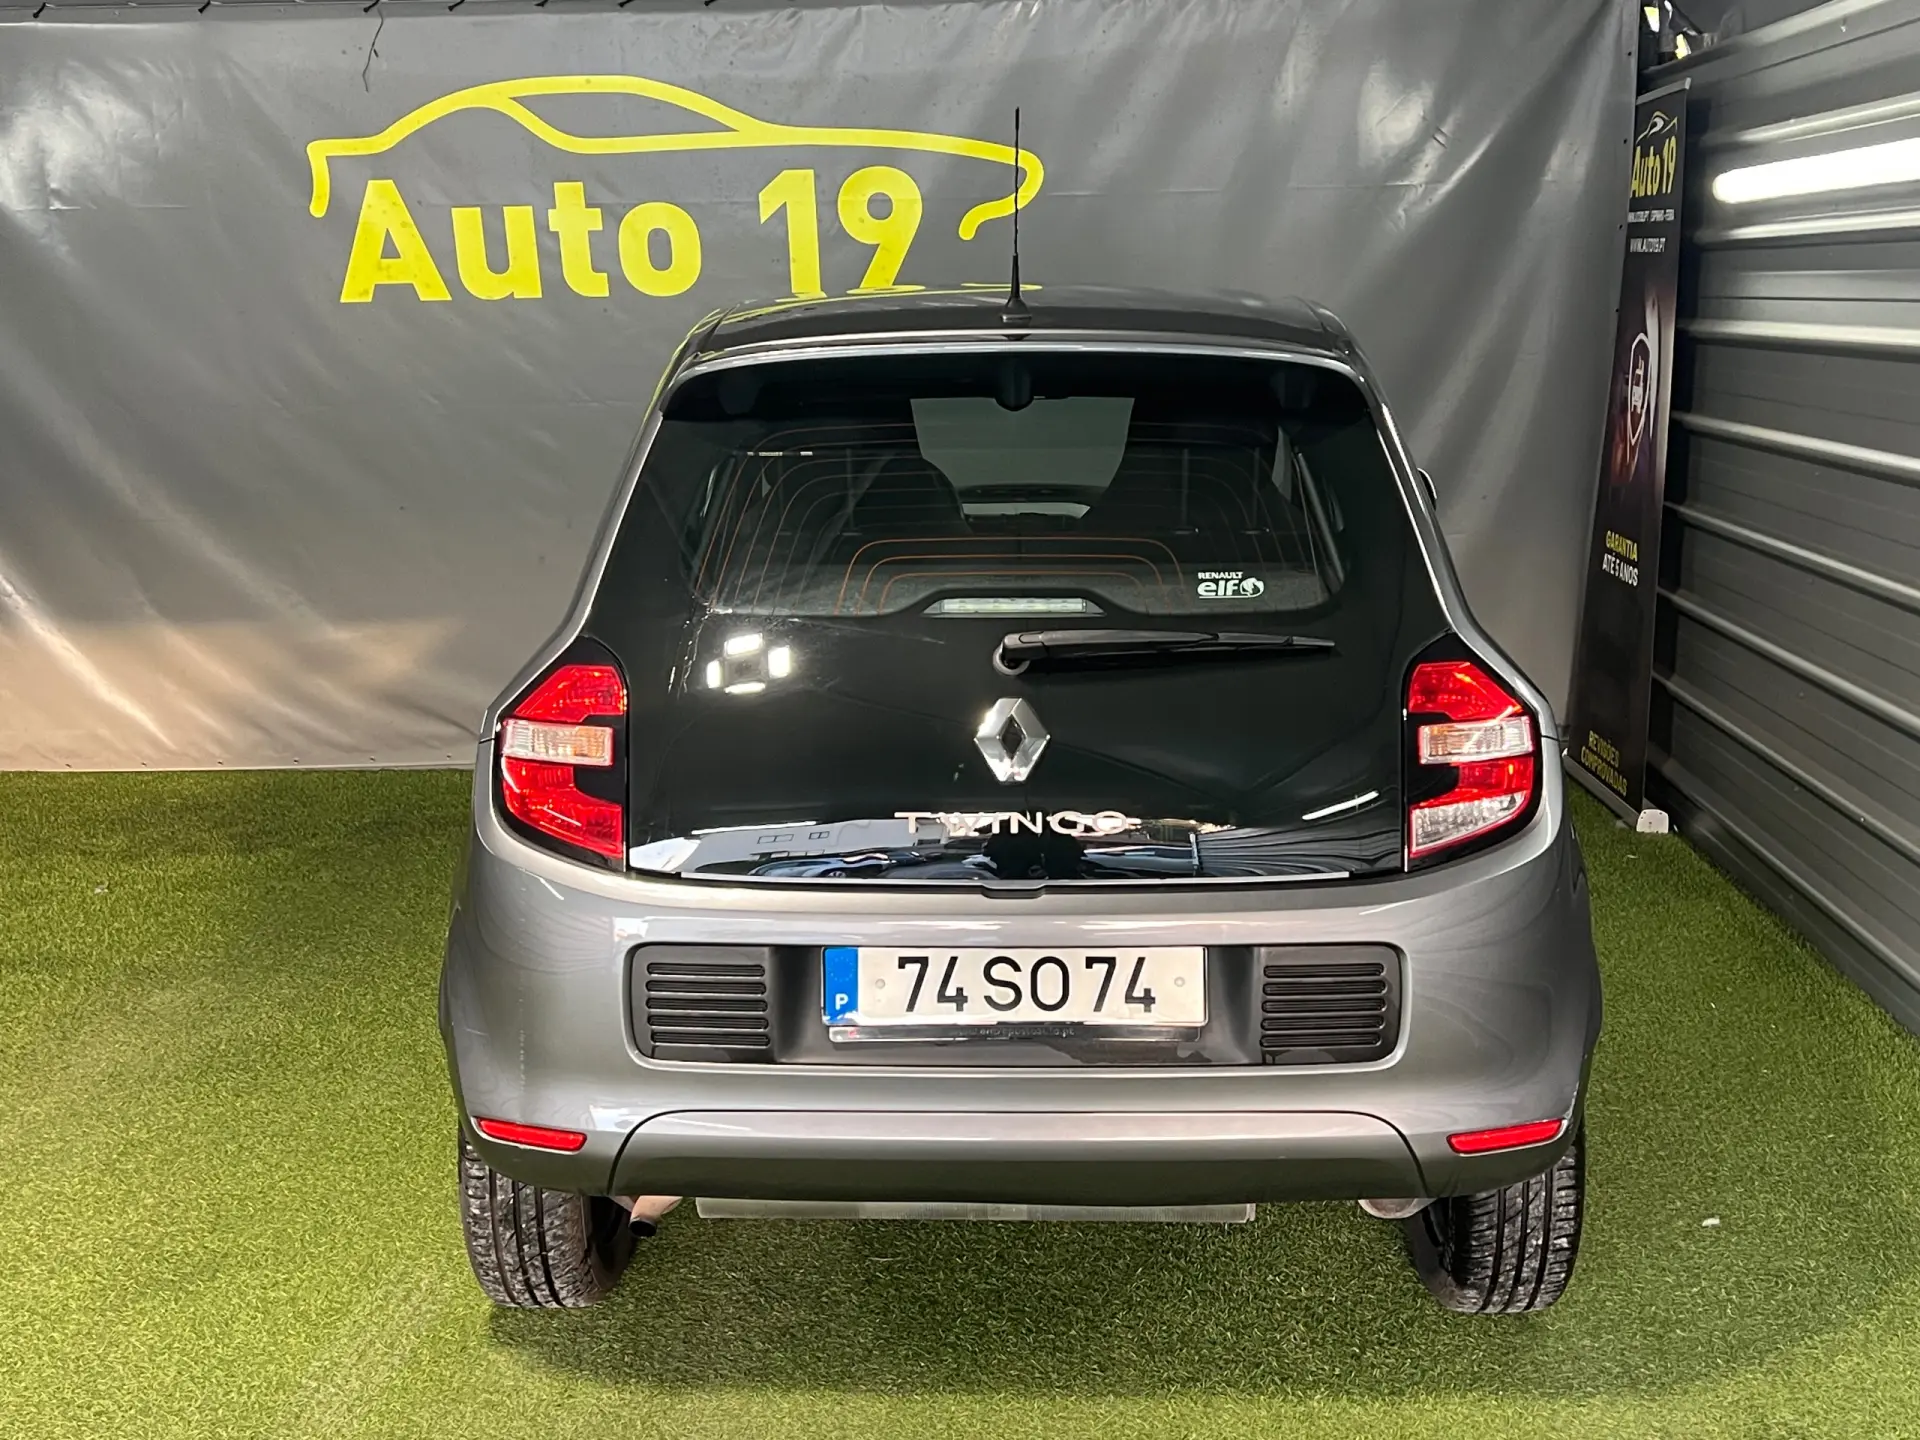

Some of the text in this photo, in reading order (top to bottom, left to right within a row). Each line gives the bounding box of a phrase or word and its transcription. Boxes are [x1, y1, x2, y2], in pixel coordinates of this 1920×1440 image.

[1630, 135, 1676, 198] Auto 19
[340, 165, 923, 303] Auto 19
[1605, 530, 1638, 562] GARANTIA
[1197, 571, 1244, 580] RENAULT
[1602, 552, 1639, 587] ATÉ 5 ANOS
[1197, 579, 1240, 597] elf
[894, 810, 1129, 837] TWINGO
[835, 993, 849, 1011] P
